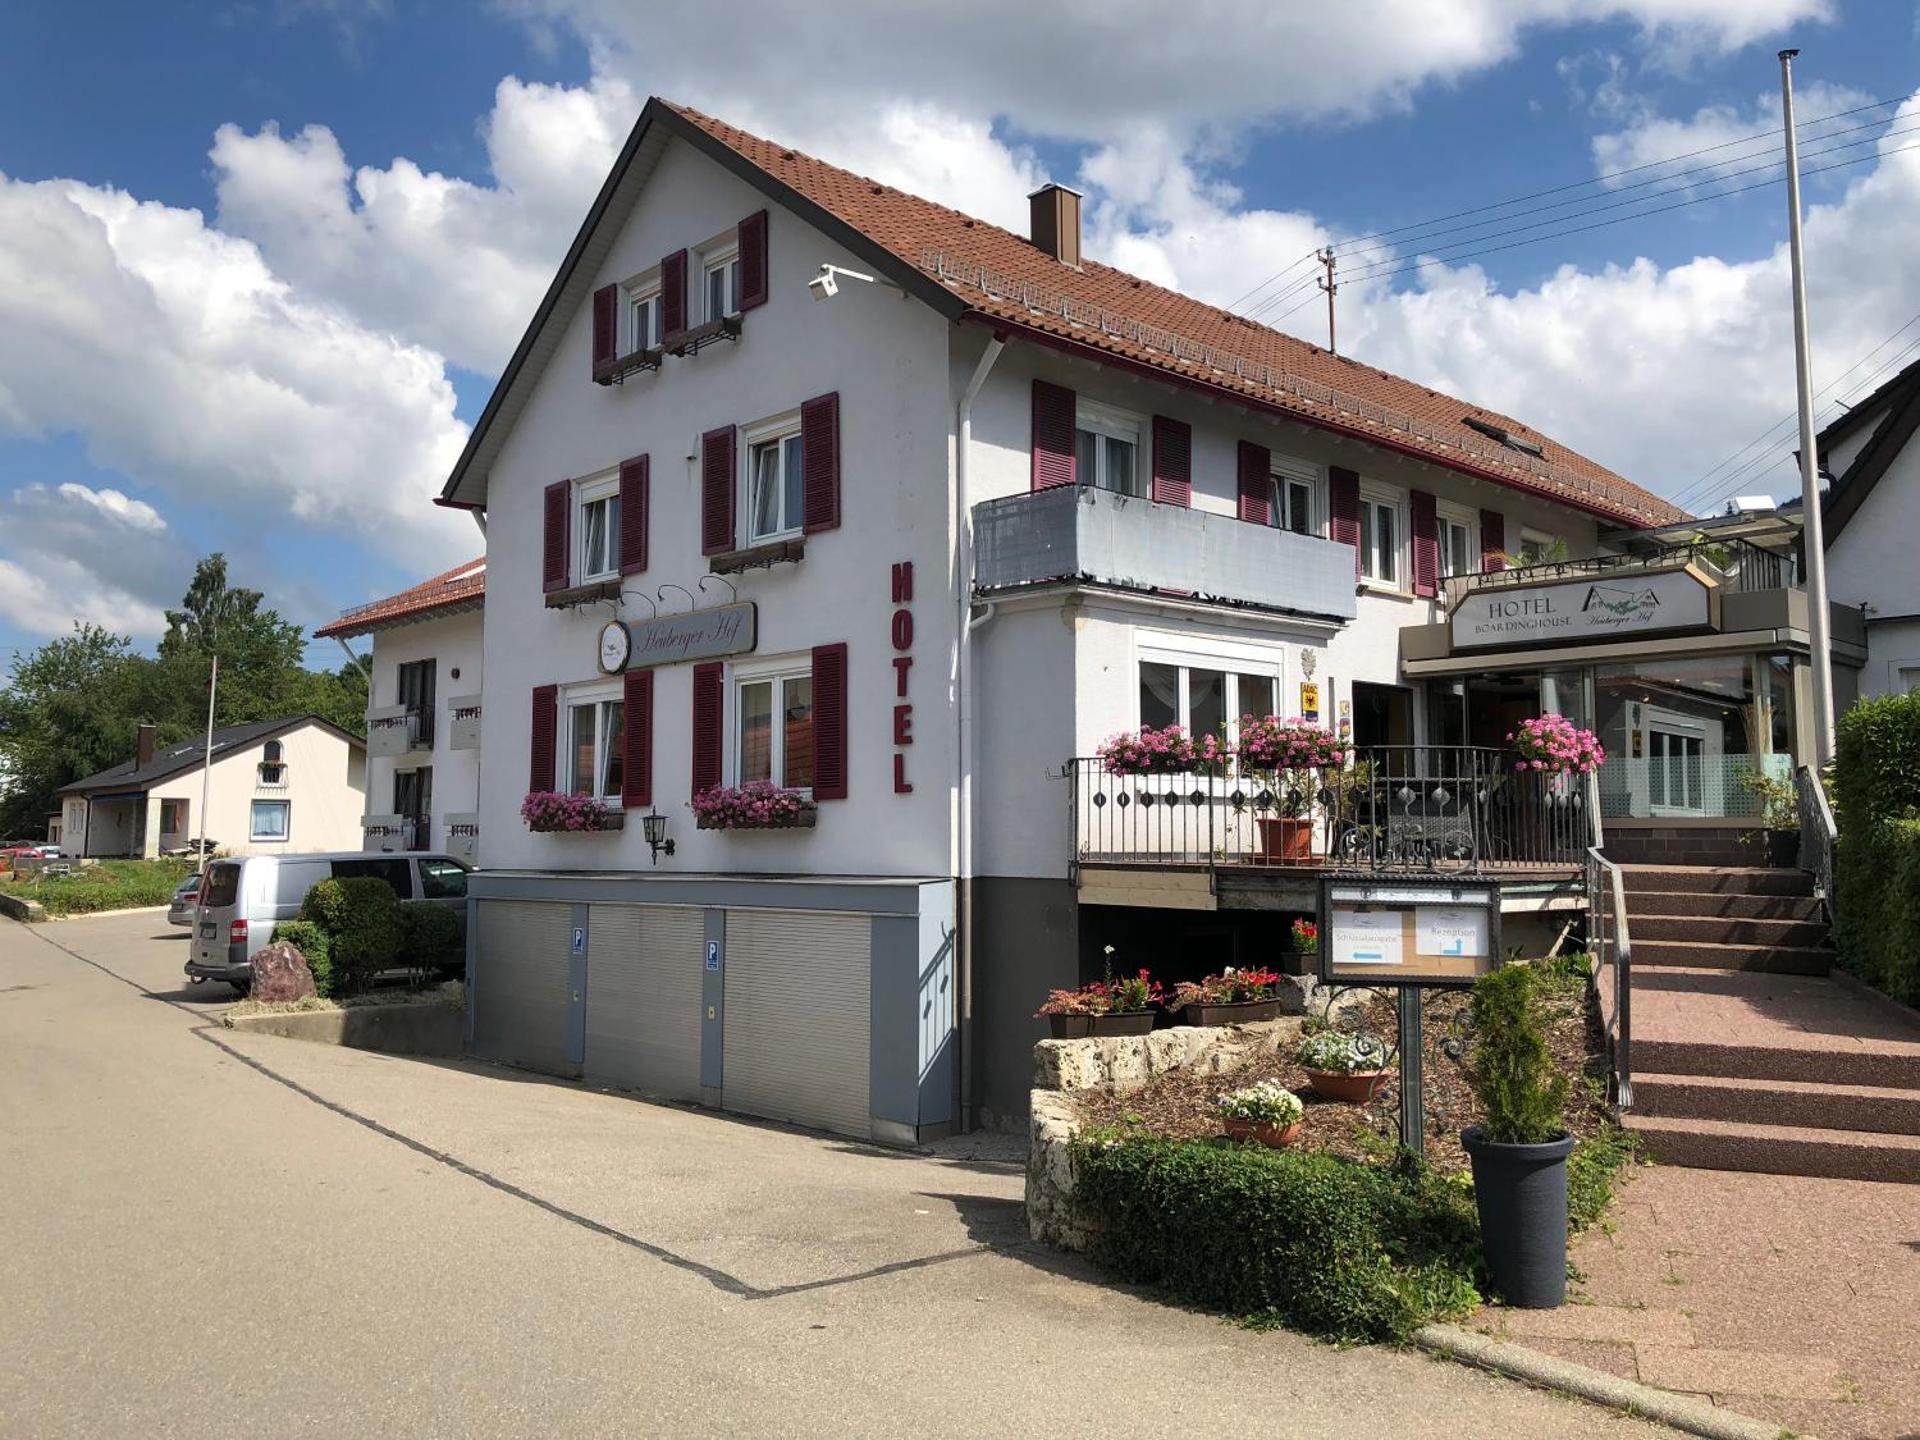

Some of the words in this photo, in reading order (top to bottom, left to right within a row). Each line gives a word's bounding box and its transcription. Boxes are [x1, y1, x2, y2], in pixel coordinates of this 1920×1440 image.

[1489, 598, 1556, 618] HOTEL
[709, 612, 743, 646] Hof
[1475, 616, 1573, 633] BOARDINGHOUSE
[892, 562, 913, 793] HOTEL
[709, 943, 716, 959] P
